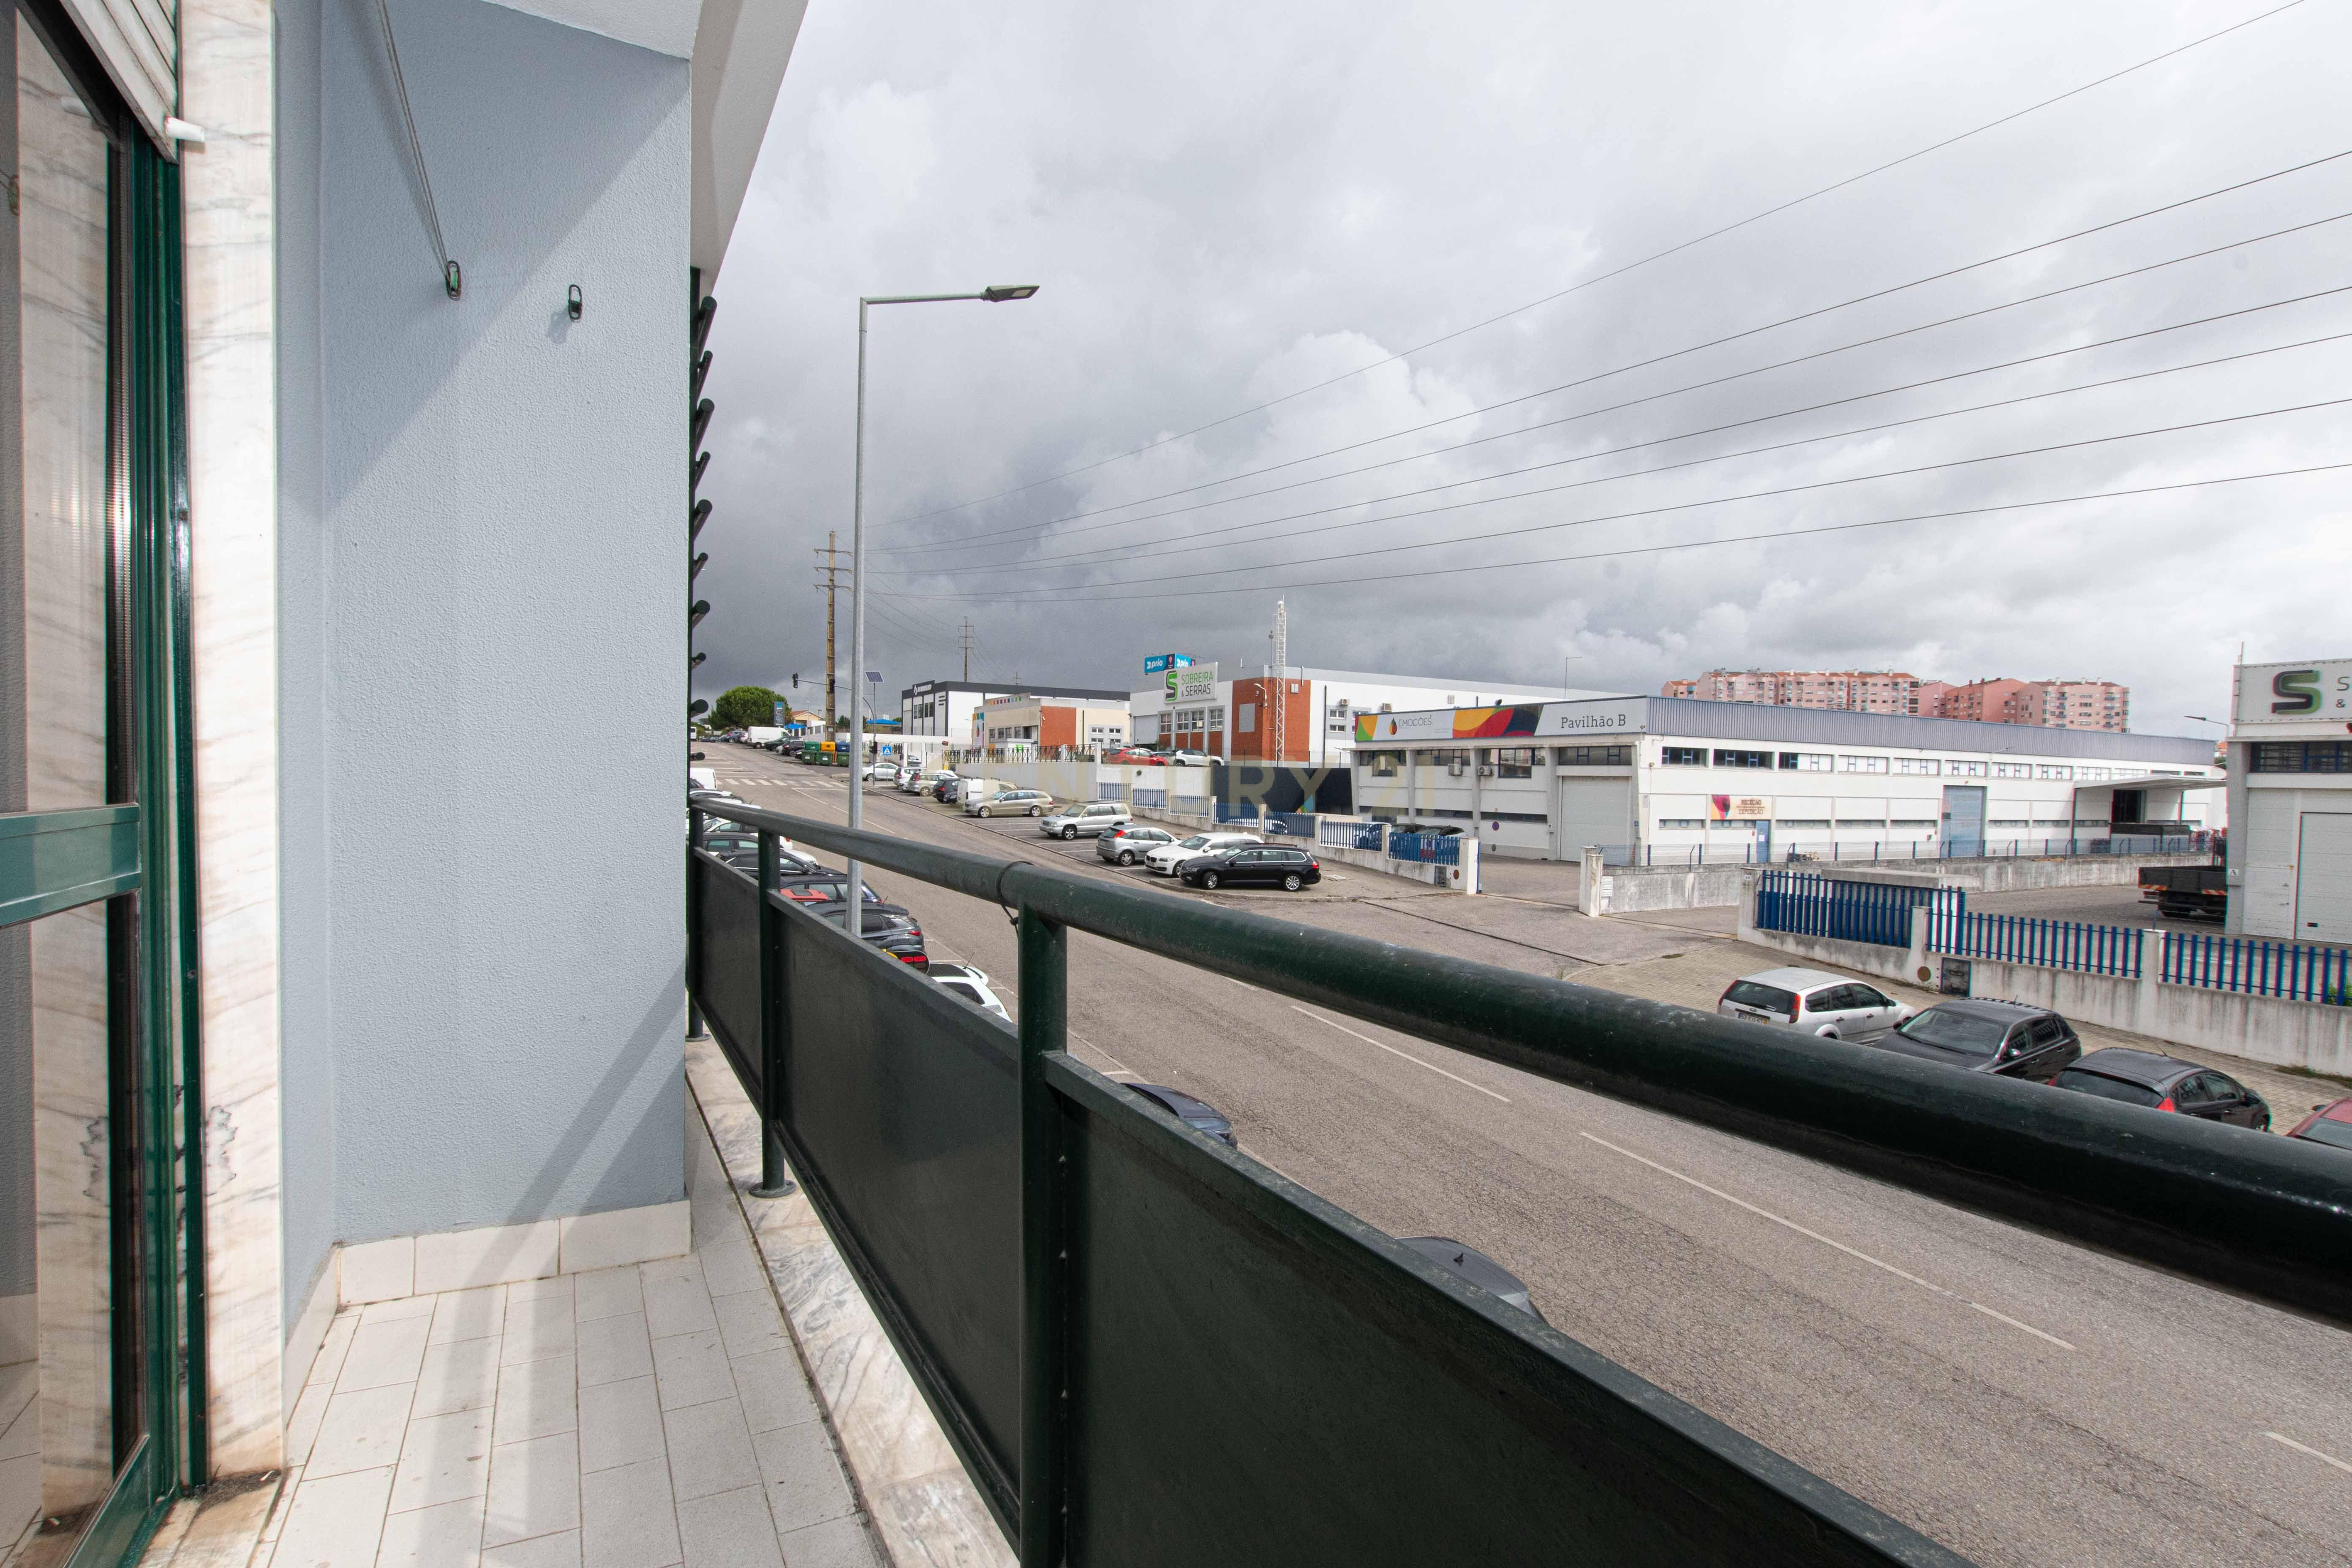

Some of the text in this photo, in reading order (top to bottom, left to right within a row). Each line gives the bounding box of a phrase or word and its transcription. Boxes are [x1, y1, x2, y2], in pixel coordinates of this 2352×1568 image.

[1152, 658, 1163, 669] prio
[1181, 671, 1213, 685] SOBREIRA
[1186, 683, 1211, 697] SERRAS
[2336, 699, 2346, 708] &
[1561, 714, 1626, 729] Pavilhão B
